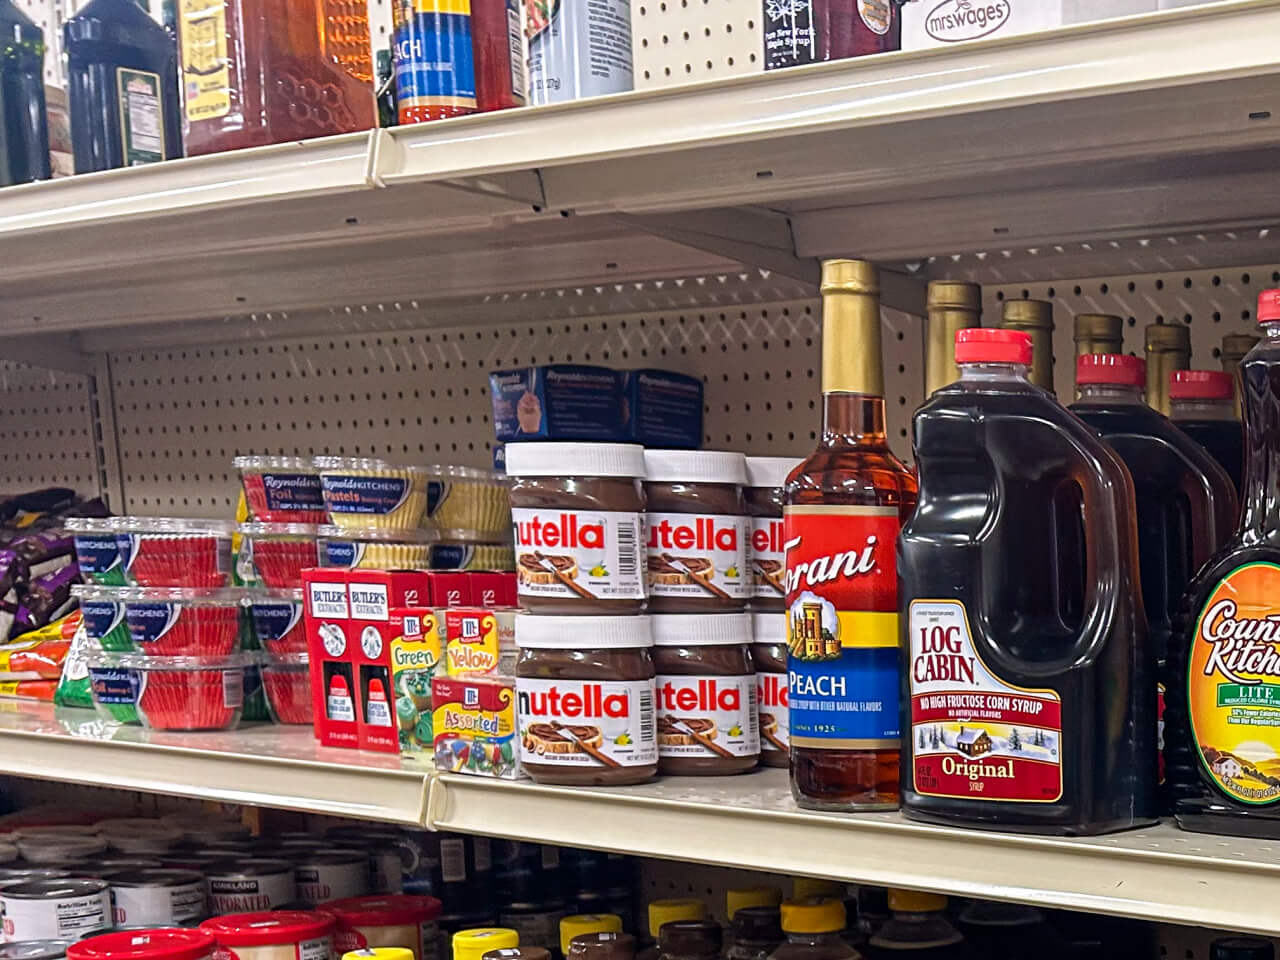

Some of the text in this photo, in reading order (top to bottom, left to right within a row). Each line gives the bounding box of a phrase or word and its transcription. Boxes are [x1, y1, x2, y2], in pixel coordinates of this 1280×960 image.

[352, 590, 385, 604] BUTLER'S
[920, 626, 962, 653] LOG
[395, 647, 434, 665] Green
[449, 646, 493, 668] Yellow
[914, 654, 976, 684] CABIN
[789, 671, 846, 696] PEACH
[1239, 686, 1274, 699] LITE
[518, 685, 629, 717] nutella
[920, 695, 1042, 715] NO HIGH FRUCTOSE CORN SYRUP
[445, 709, 498, 733] Assorted
[942, 757, 1015, 780] Original
[969, 781, 984, 791] SYRUP
